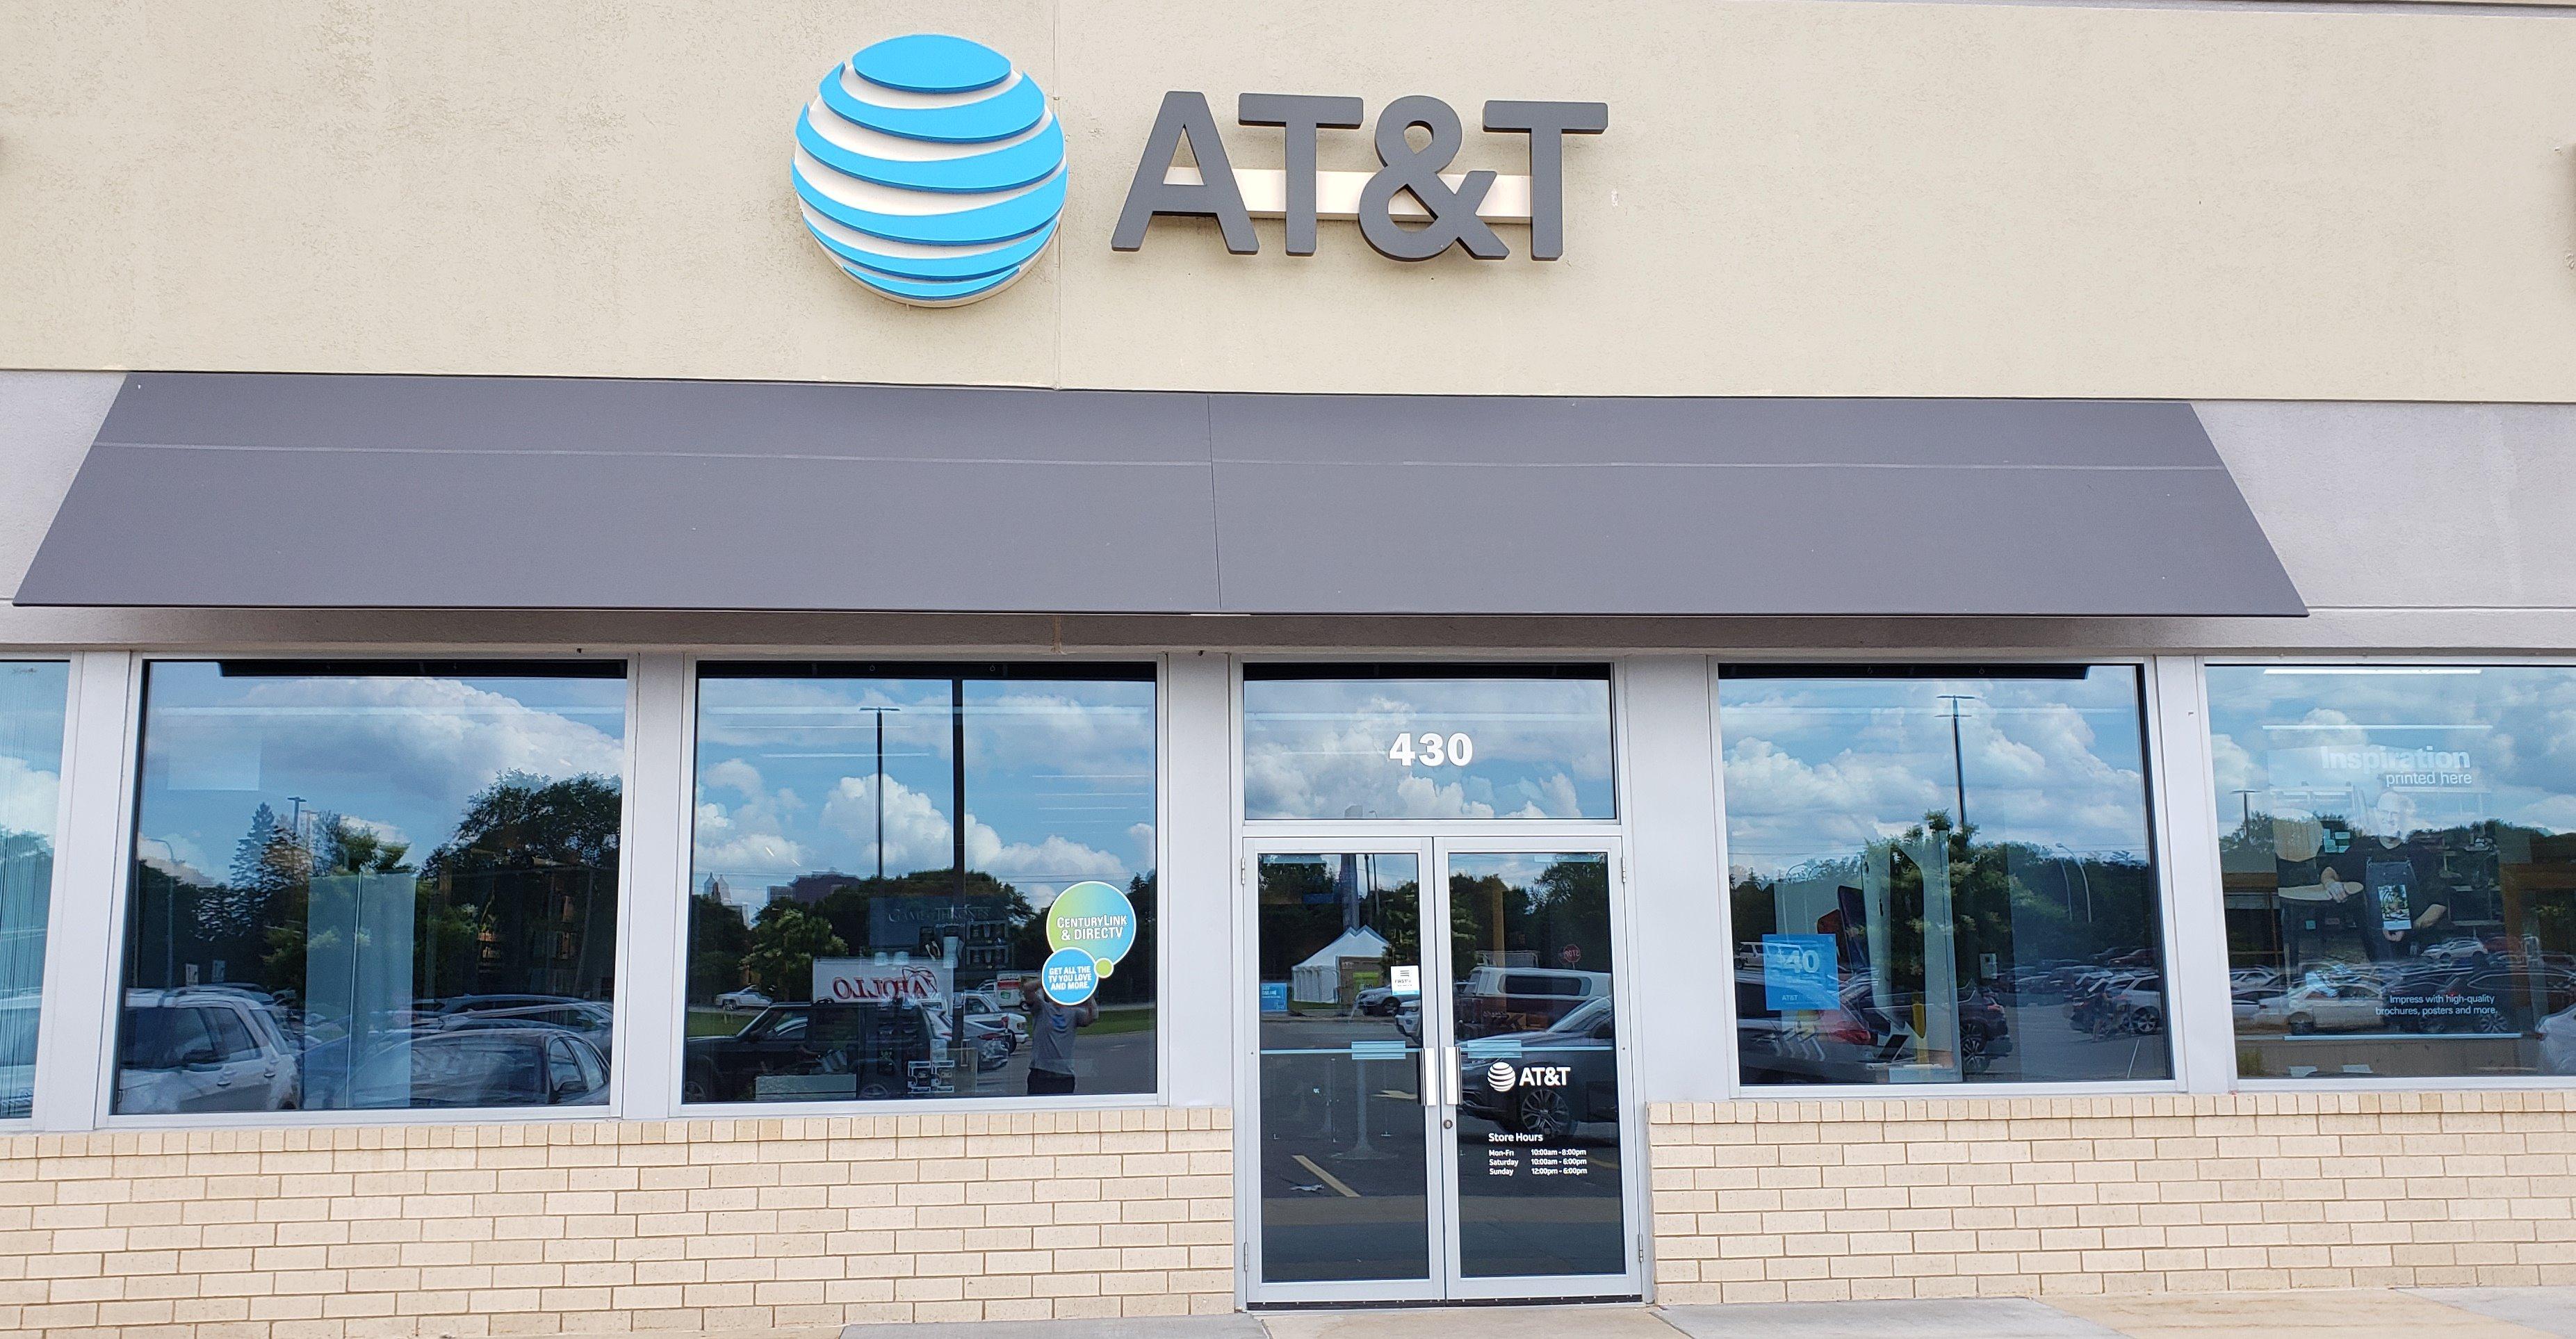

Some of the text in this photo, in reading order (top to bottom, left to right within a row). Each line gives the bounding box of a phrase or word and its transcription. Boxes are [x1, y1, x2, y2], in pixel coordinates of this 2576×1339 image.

[1111, 90, 1608, 261] AT&T
[1389, 732, 1474, 767] 430
[2320, 745, 2470, 774] Inspiration
[2386, 772, 2472, 787] printed here
[1061, 926, 1123, 941] & DIRECTV
[1050, 967, 1063, 975] GET
[1048, 975, 1057, 983] TV
[1050, 981, 1090, 991] AND MORE.
[2390, 993, 2495, 1005] Impress with high-quality
[2375, 1007, 2420, 1016] brochures,
[2422, 1007, 2453, 1017] posters
[2455, 1005, 2471, 1014] and
[1519, 1066, 1571, 1087] AT&T
[1488, 1133, 1544, 1142] Store Hours
[1561, 1149, 1587, 1157] 8:00pm
[1489, 1159, 1519, 1167] Saturday
[1563, 1158, 1588, 1167] 6:00pm
[1489, 1168, 1514, 1176] Sunday
[1531, 1167, 1558, 1176] 12:00pm
[1563, 1167, 1588, 1176] 6:00pm
